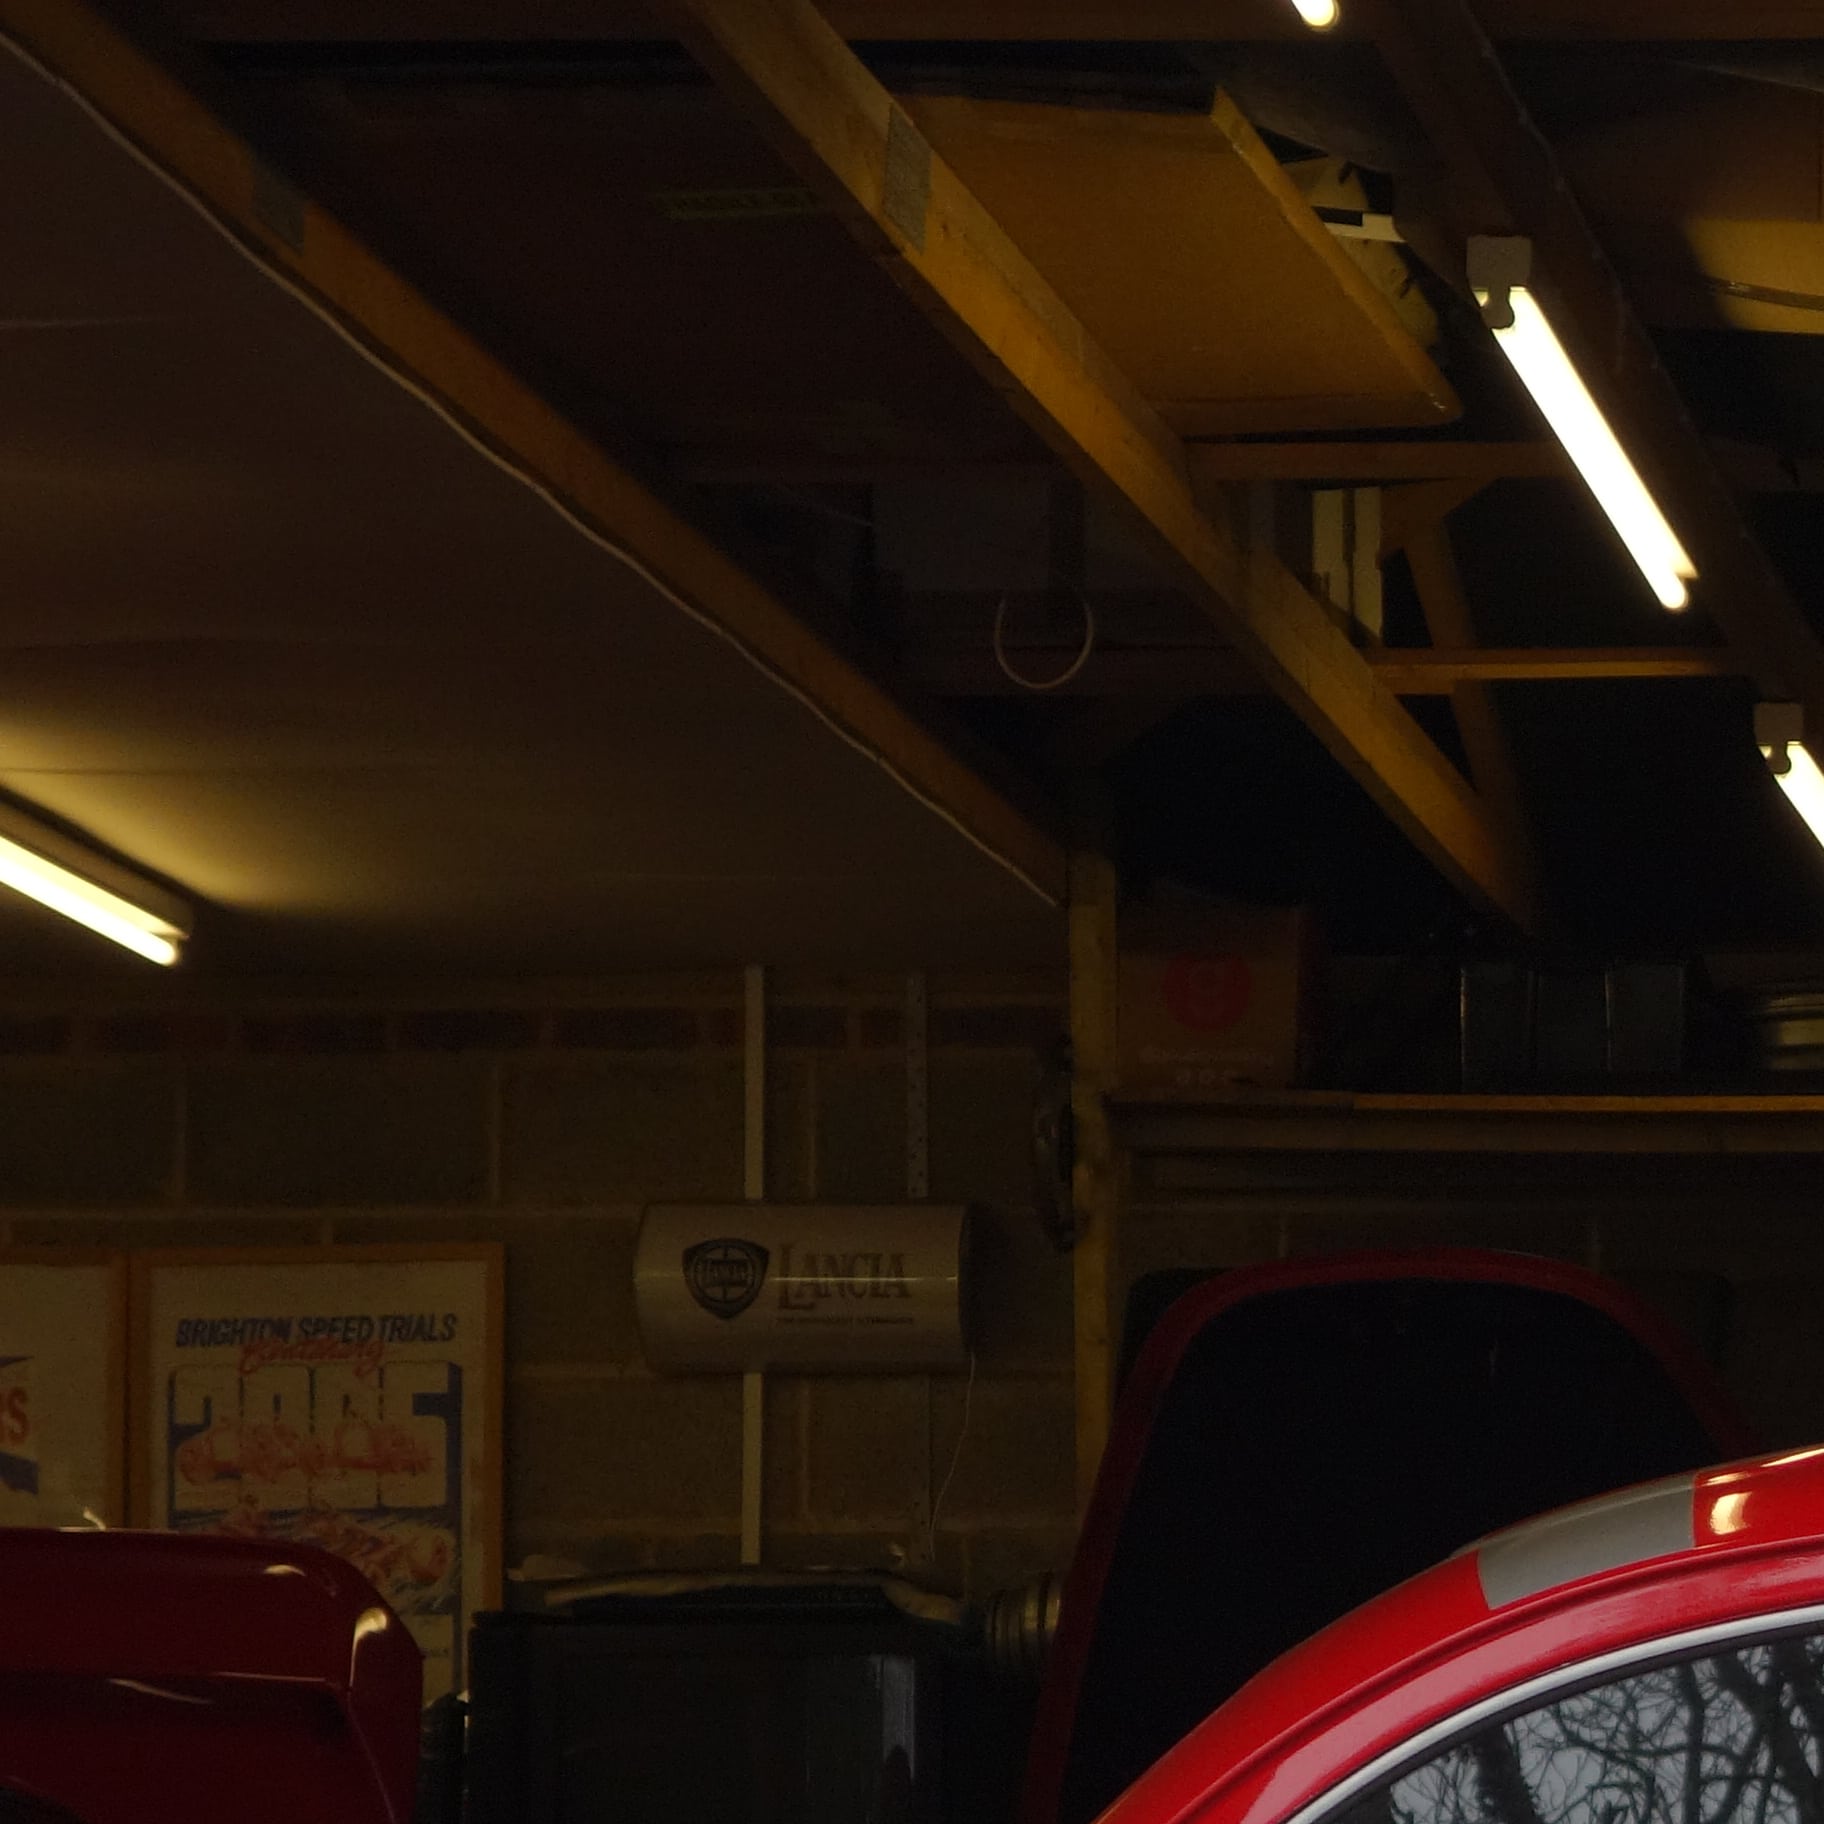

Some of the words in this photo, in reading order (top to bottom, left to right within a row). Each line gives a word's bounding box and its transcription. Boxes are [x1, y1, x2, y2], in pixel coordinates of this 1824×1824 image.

[175, 1316, 292, 1348] BRIGHTON
[298, 1314, 376, 1344] SPEED
[380, 1312, 458, 1342] TRIALS
